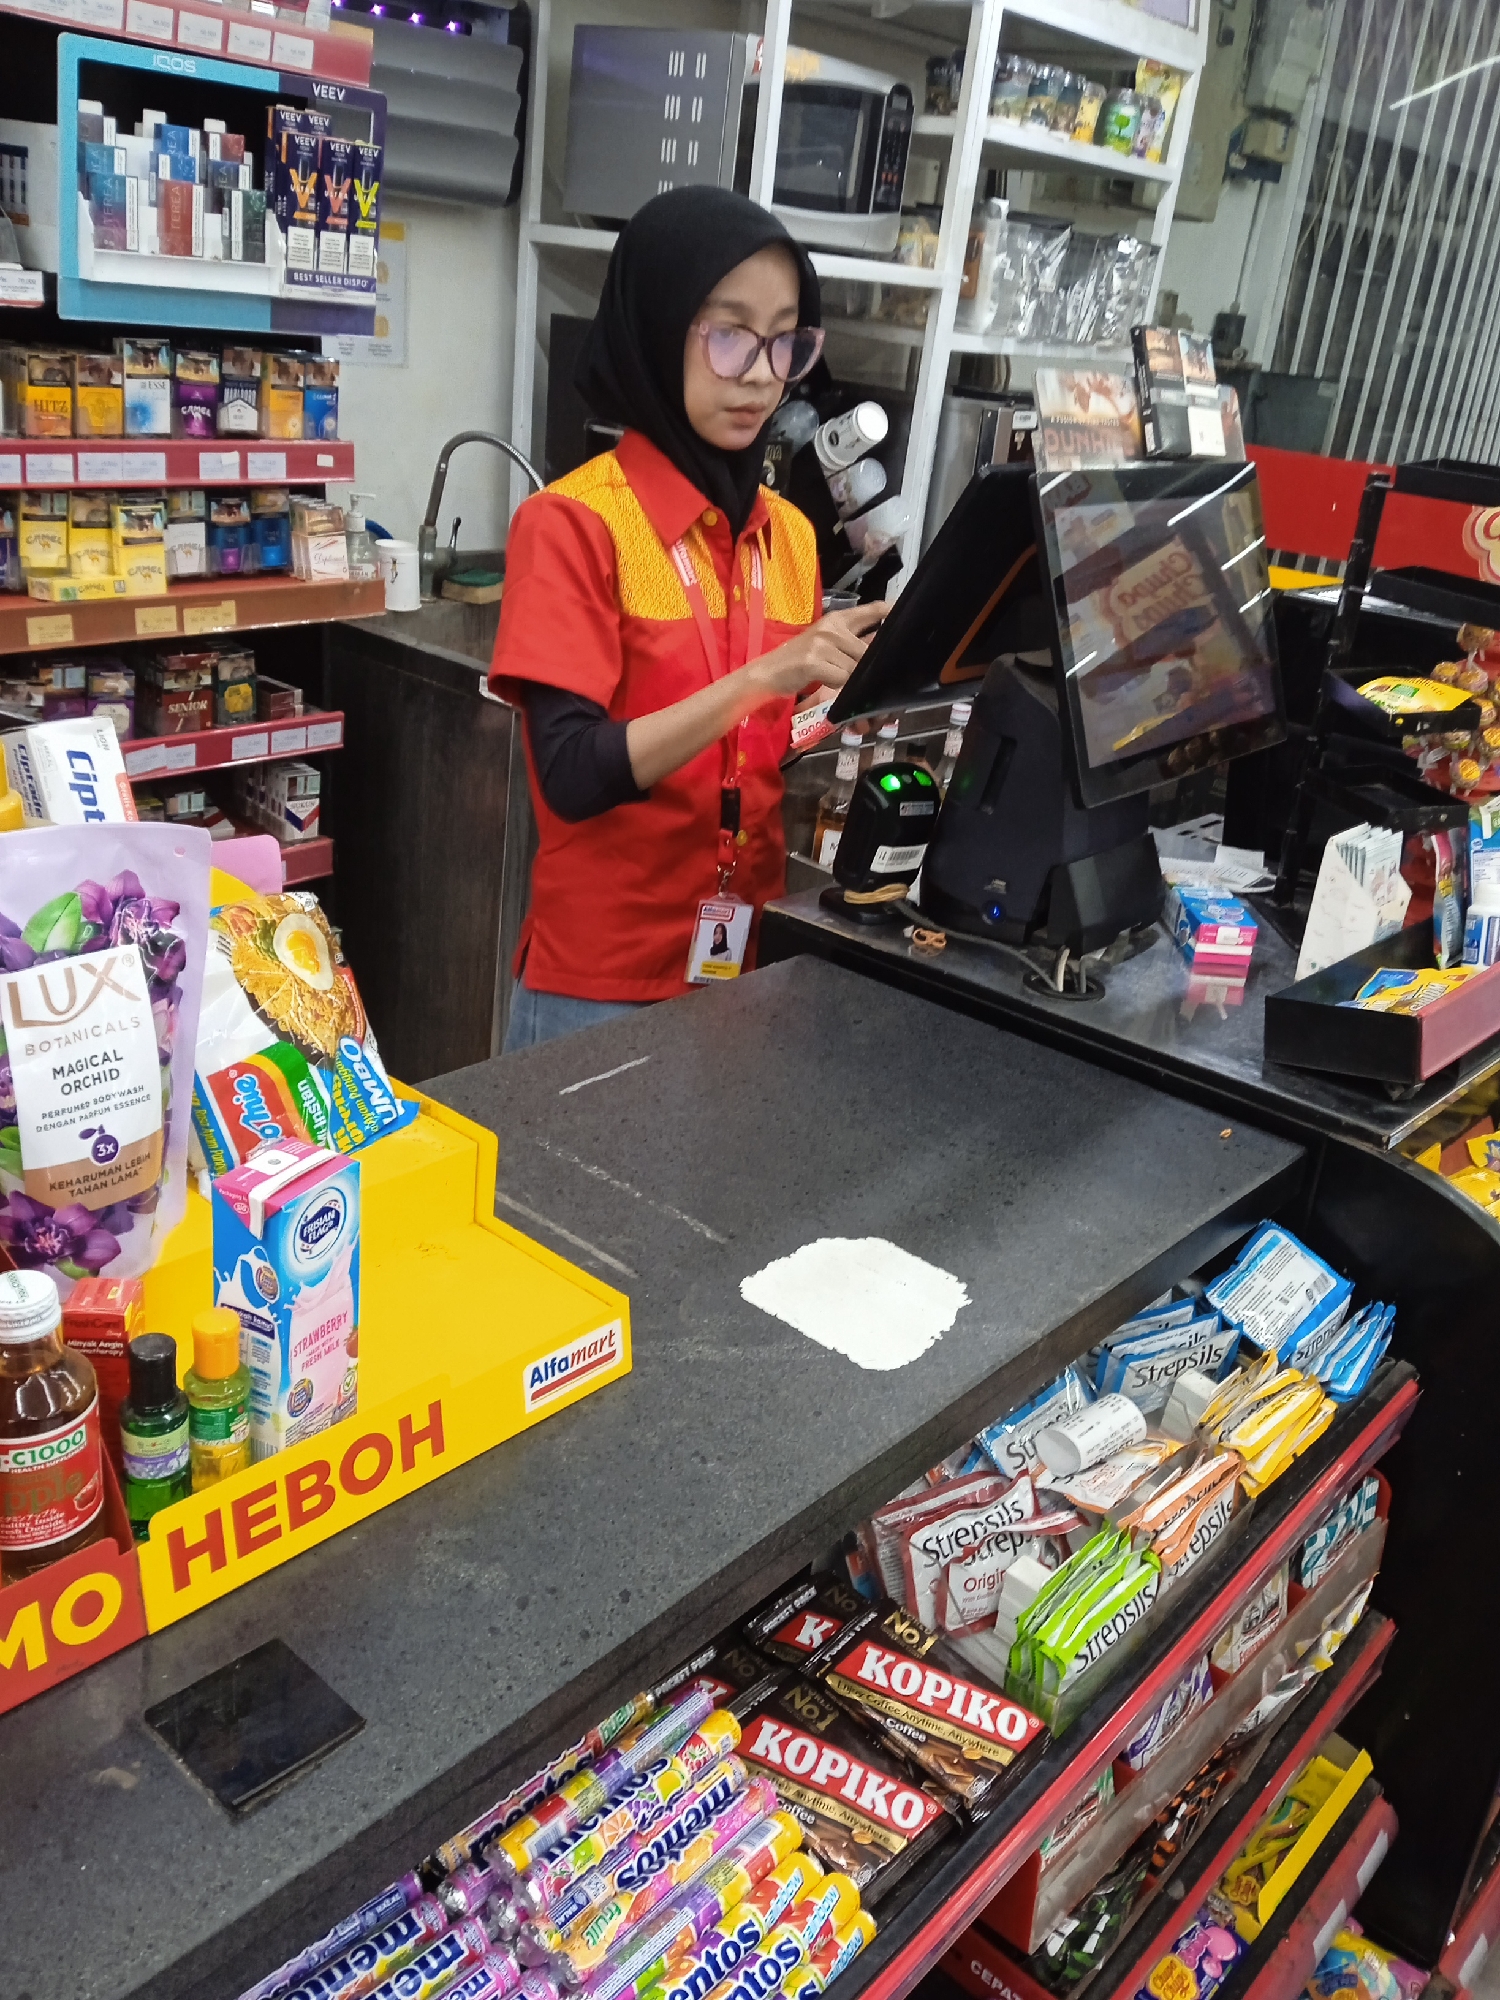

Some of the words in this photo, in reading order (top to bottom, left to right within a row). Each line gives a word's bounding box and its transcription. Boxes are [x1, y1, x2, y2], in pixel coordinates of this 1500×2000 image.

[152, 53, 197, 74] IQOS
[312, 82, 346, 101] VEEV
[280, 111, 301, 122] VEEV
[308, 115, 330, 127] VEEV
[295, 134, 316, 147] VEEV
[330, 141, 351, 154] VEEV
[359, 147, 379, 157] VEEV
[293, 272, 313, 282] BEST
[315, 274, 343, 286] SELLER
[33, 400, 68, 413] HITZ
[181, 404, 212, 418] CAMEL
[25, 534, 62, 545] CAMEL
[127, 565, 163, 577] CAMEL
[78, 583, 106, 594] CAMEL
[168, 700, 208, 713] SENIOR
[7, 956, 141, 1029] LUX
[25, 1016, 140, 1056] BOTANICALS
[52, 1048, 123, 1082] MAGICAL
[60, 1067, 120, 1096] ORCHID
[92, 1084, 145, 1107] BODYWASH
[297, 1079, 329, 1130] Instan
[96, 1142, 116, 1158] 3x
[49, 1165, 123, 1194] KEHARUMAN
[125, 1153, 151, 1173] LEBIH
[68, 1182, 108, 1199] TAHAN
[302, 1209, 336, 1238] FRISIAN
[309, 1226, 328, 1244] FLAG
[99, 1340, 123, 1350] Angin
[293, 1311, 348, 1357] STRAWBERRY
[301, 1353, 323, 1372] FRESH
[324, 1339, 340, 1355] MILK
[530, 1328, 617, 1387] Alfamart
[1131, 1350, 1223, 1389] Strepsils
[12, 1430, 84, 1465] C1000
[166, 1400, 445, 1593] HEBOH
[922, 1498, 1024, 1568] Strepsils
[1074, 1584, 1155, 1673] Strepsils
[857, 1645, 1028, 1742] KOPIKO
[885, 1717, 927, 1743] Coffee
[749, 1720, 926, 1830] KOPIKO
